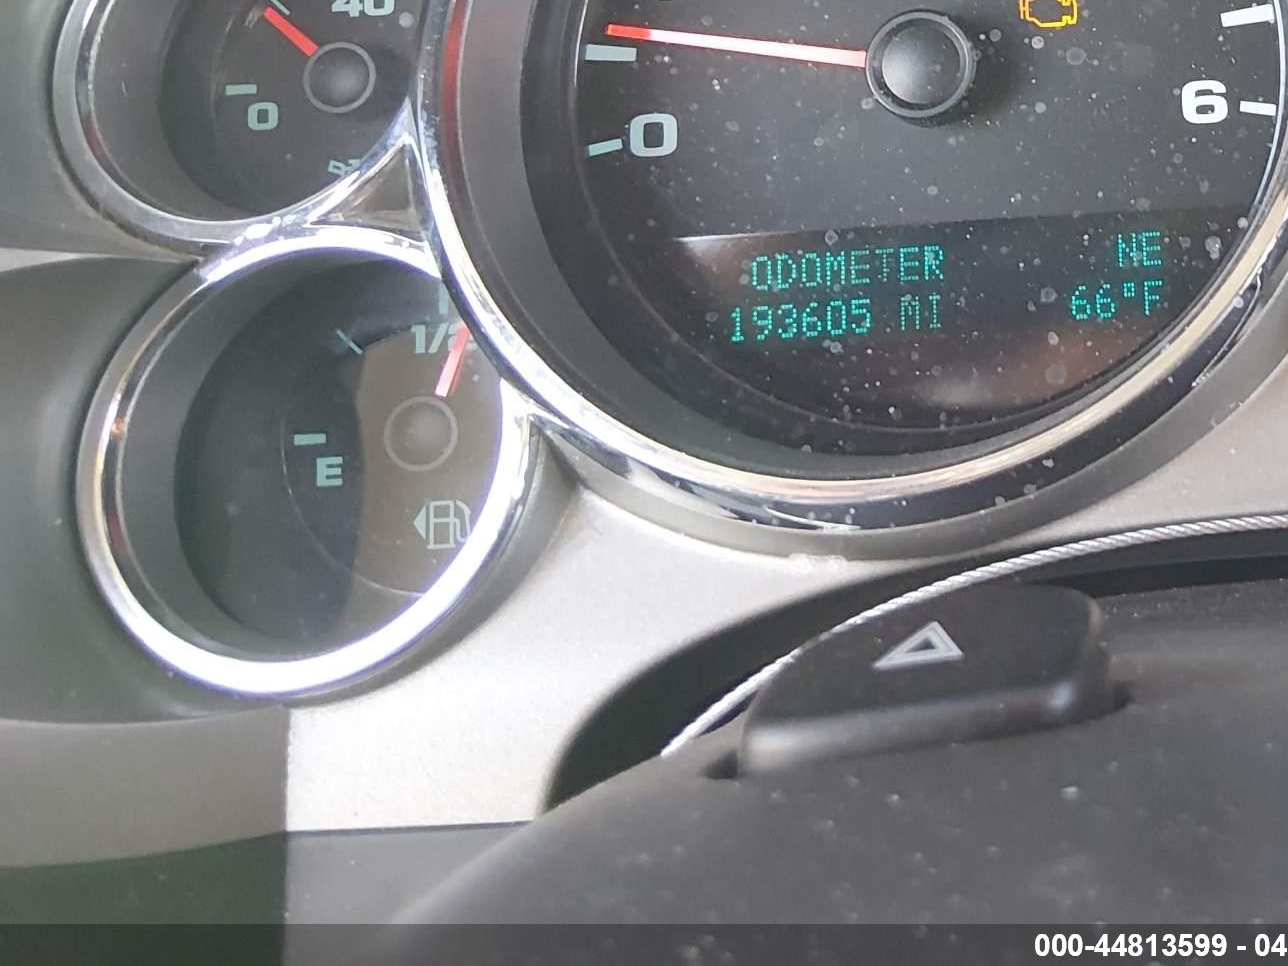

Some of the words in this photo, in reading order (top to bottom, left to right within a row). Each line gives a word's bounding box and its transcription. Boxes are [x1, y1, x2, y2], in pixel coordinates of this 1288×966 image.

[247, 101, 278, 131] 0
[1181, 79, 1228, 124] 6
[629, 112, 678, 158] 0
[752, 245, 944, 291] ODOMETER
[1117, 231, 1162, 267] NE
[731, 298, 871, 342] 193605
[900, 292, 941, 331] MI
[316, 456, 343, 487] E
